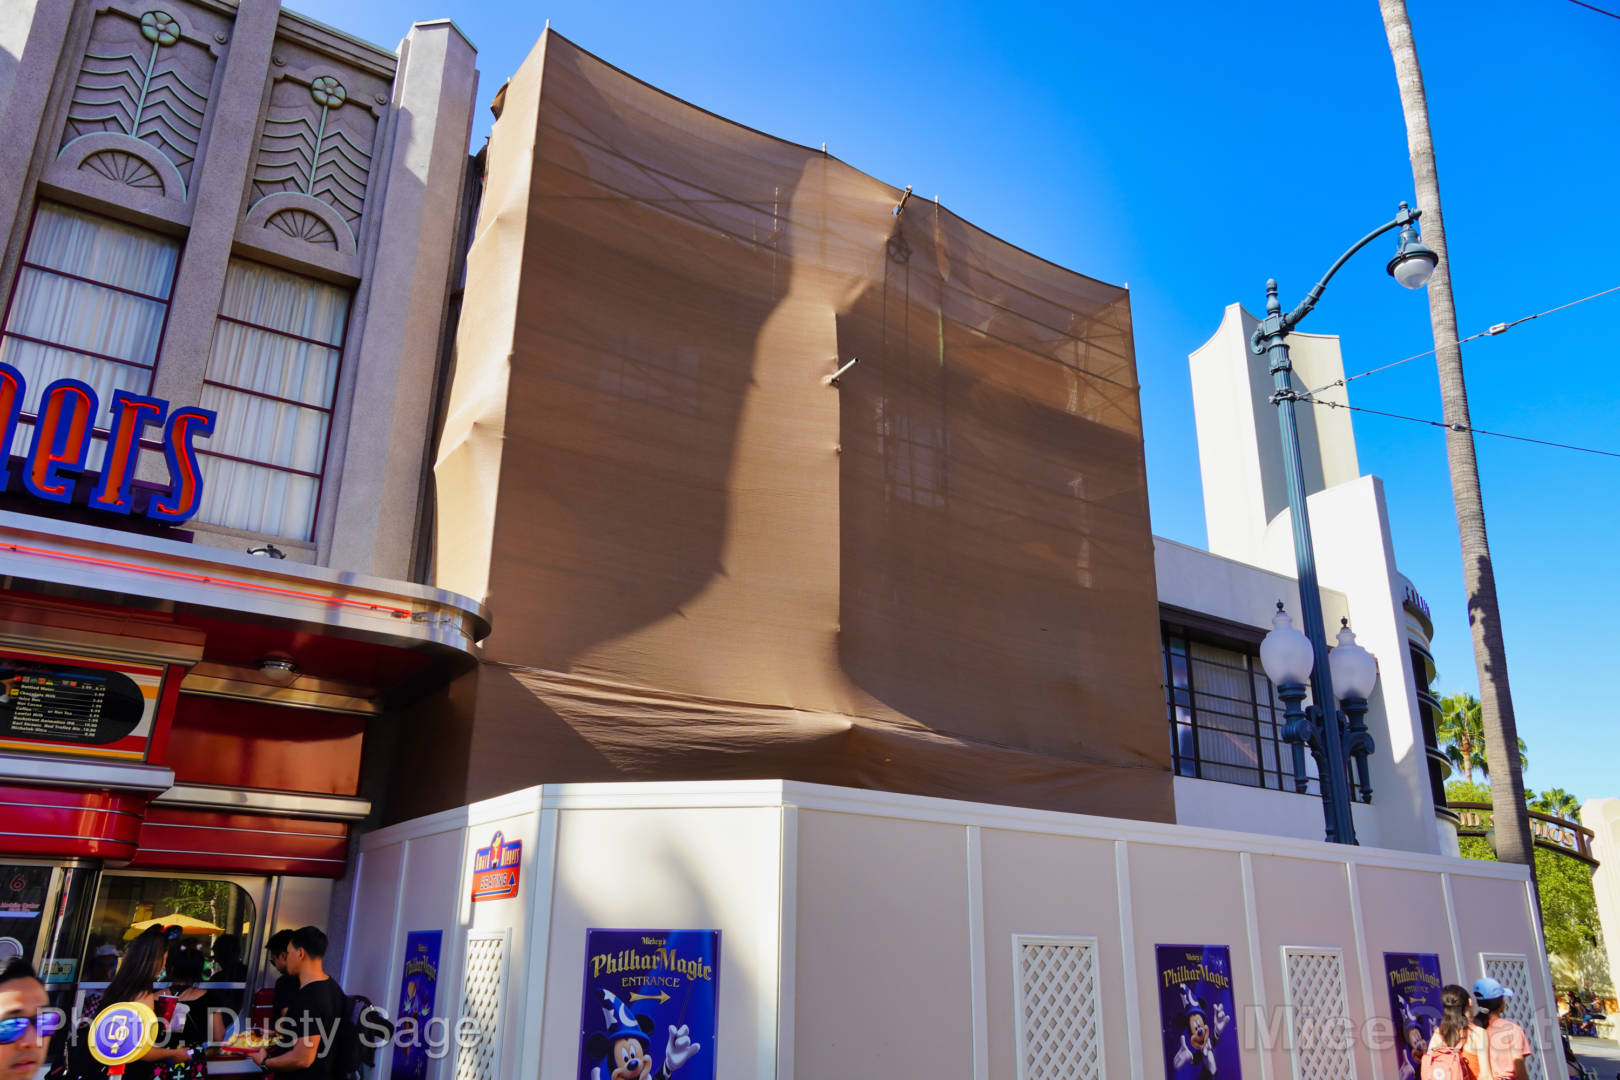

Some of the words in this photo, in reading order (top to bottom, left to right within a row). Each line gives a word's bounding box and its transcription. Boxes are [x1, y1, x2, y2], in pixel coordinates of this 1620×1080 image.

[10, 874, 26, 892] 6
[591, 947, 713, 981] PhilharMagic
[621, 976, 681, 988] ENTRANCE
[1163, 964, 1230, 989] PhilharMagic
